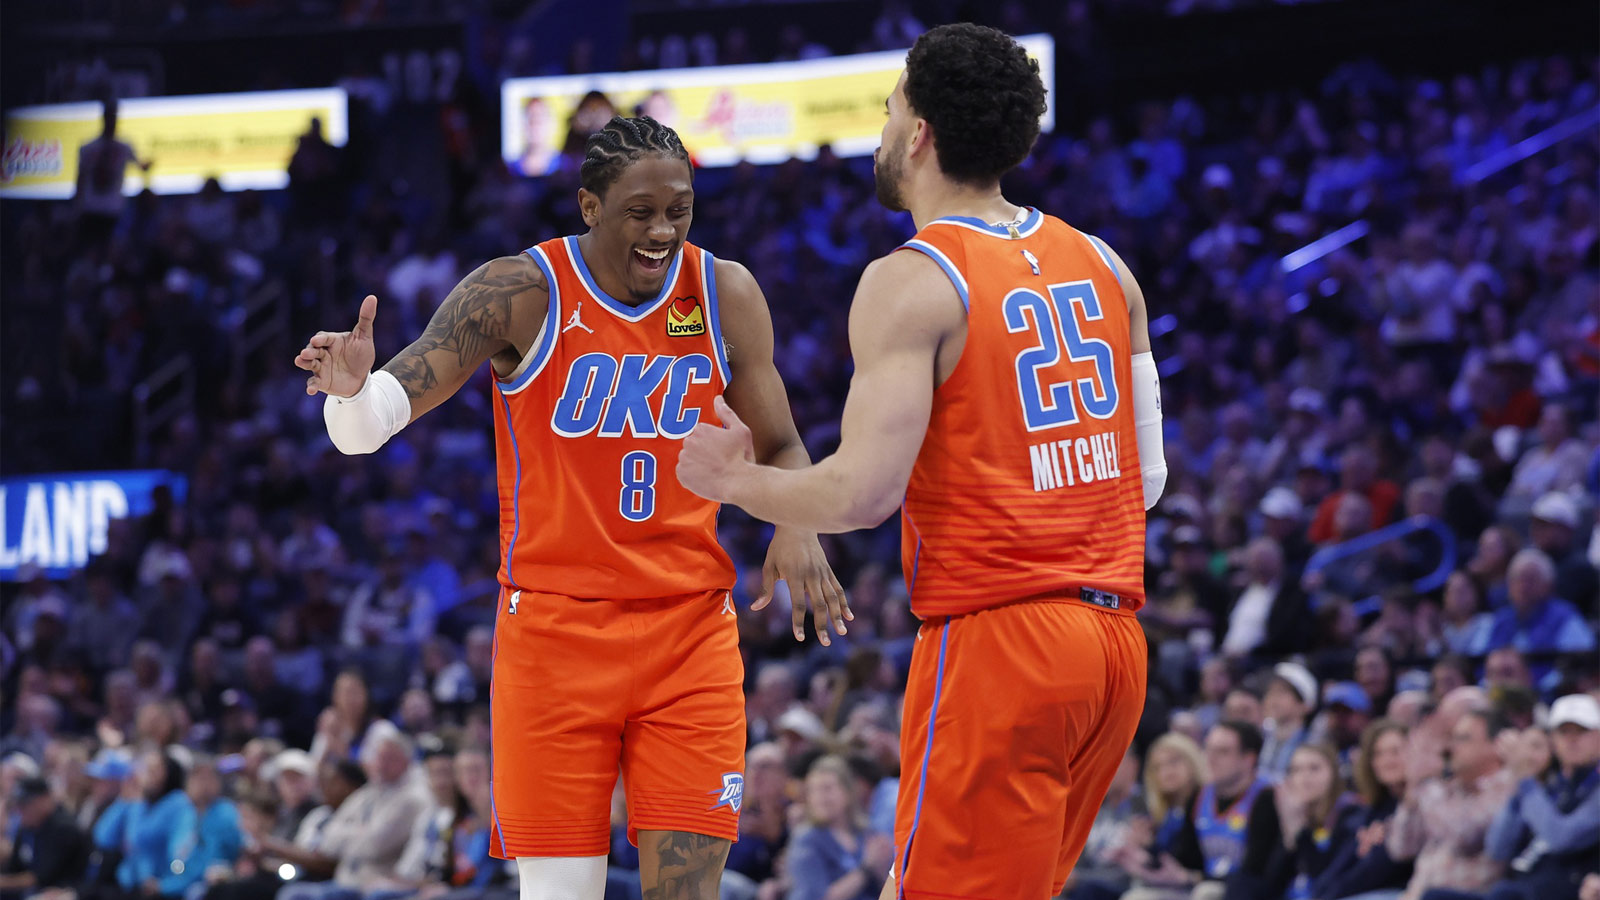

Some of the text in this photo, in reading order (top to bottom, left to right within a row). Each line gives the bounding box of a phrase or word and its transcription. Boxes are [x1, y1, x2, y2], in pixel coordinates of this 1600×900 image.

[1002, 279, 1119, 432] 25
[551, 353, 712, 439] OKC
[619, 450, 657, 522] 8
[1029, 431, 1120, 492] MITCHEL
